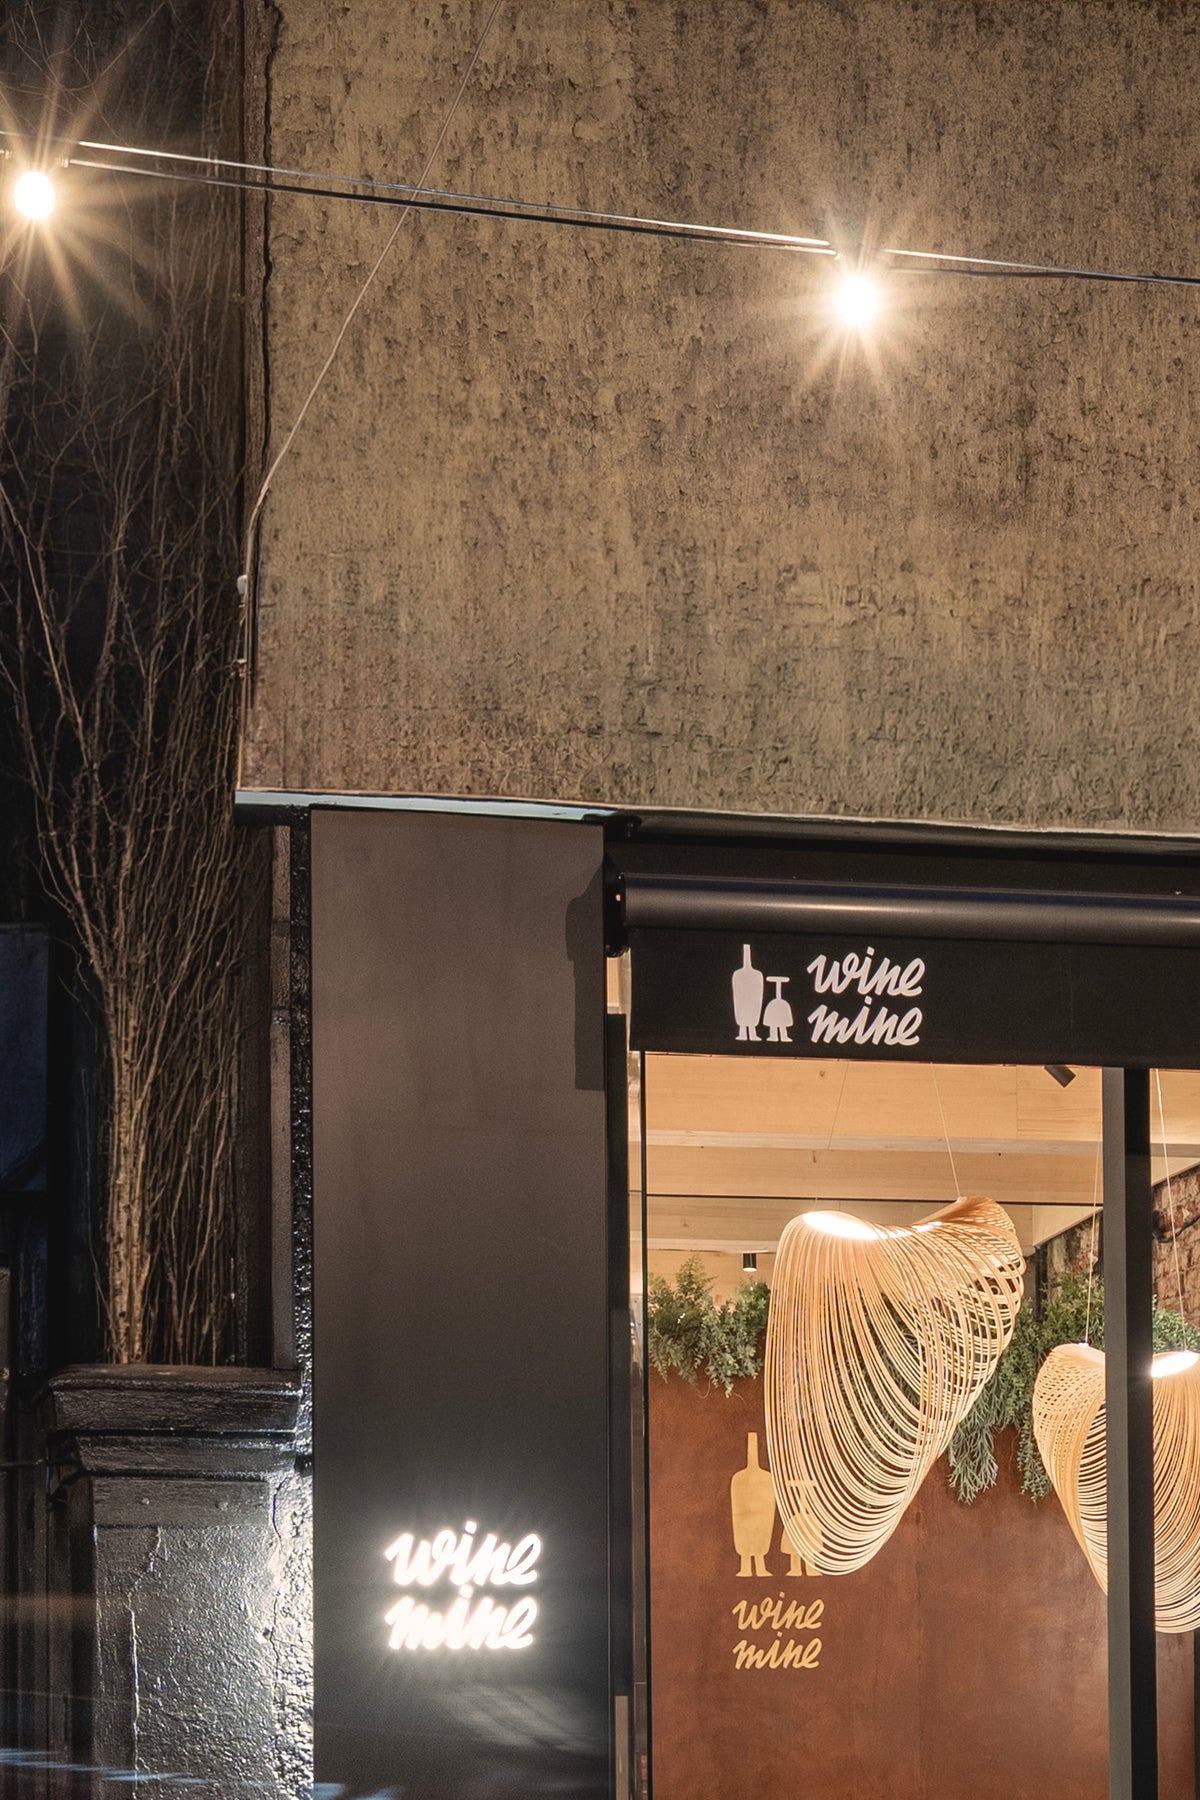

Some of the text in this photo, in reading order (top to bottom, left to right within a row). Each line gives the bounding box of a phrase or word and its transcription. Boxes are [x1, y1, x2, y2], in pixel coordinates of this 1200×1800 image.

[807, 946, 926, 997] wine
[807, 995, 923, 1046] mine
[384, 1520, 542, 1586] wine
[384, 1584, 538, 1650] mine
[732, 1591, 825, 1630] wine
[732, 1631, 823, 1670] mine
